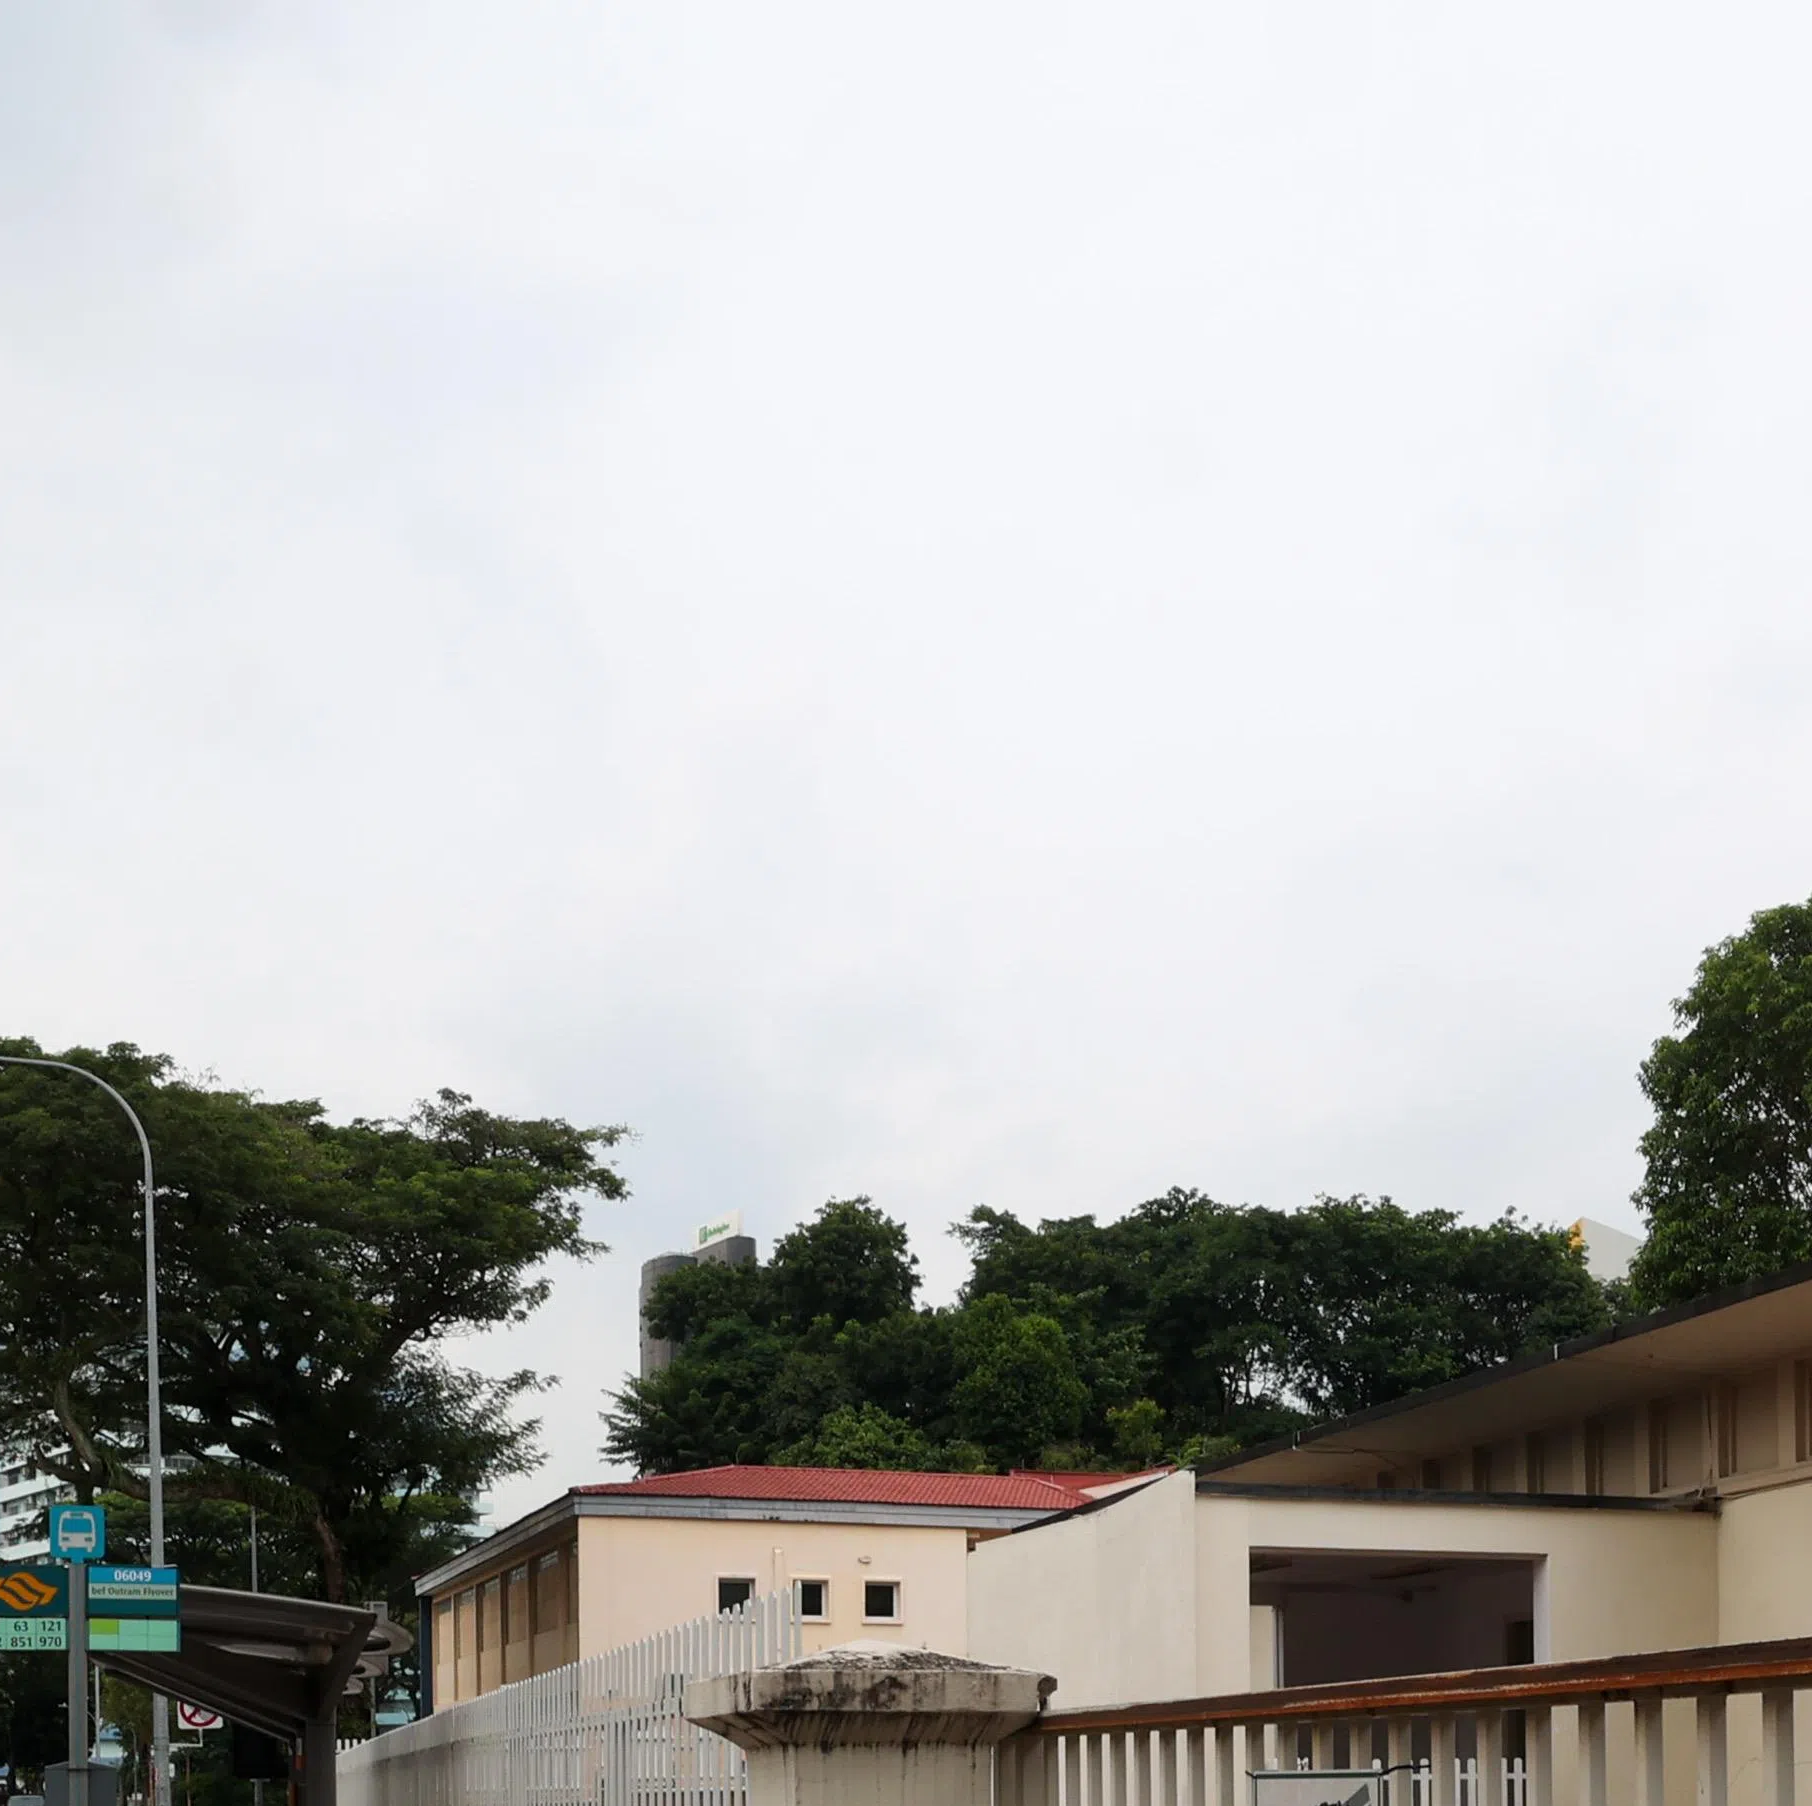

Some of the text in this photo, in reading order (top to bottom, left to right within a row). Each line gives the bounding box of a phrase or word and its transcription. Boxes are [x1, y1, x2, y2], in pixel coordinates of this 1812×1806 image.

[114, 1570, 152, 1582] 06049
[91, 1585, 174, 1598] bef Outram Flyover
[14, 1621, 28, 1632] 63
[42, 1621, 61, 1632] 121
[11, 1636, 32, 1647] 851
[39, 1636, 62, 1647] 970
